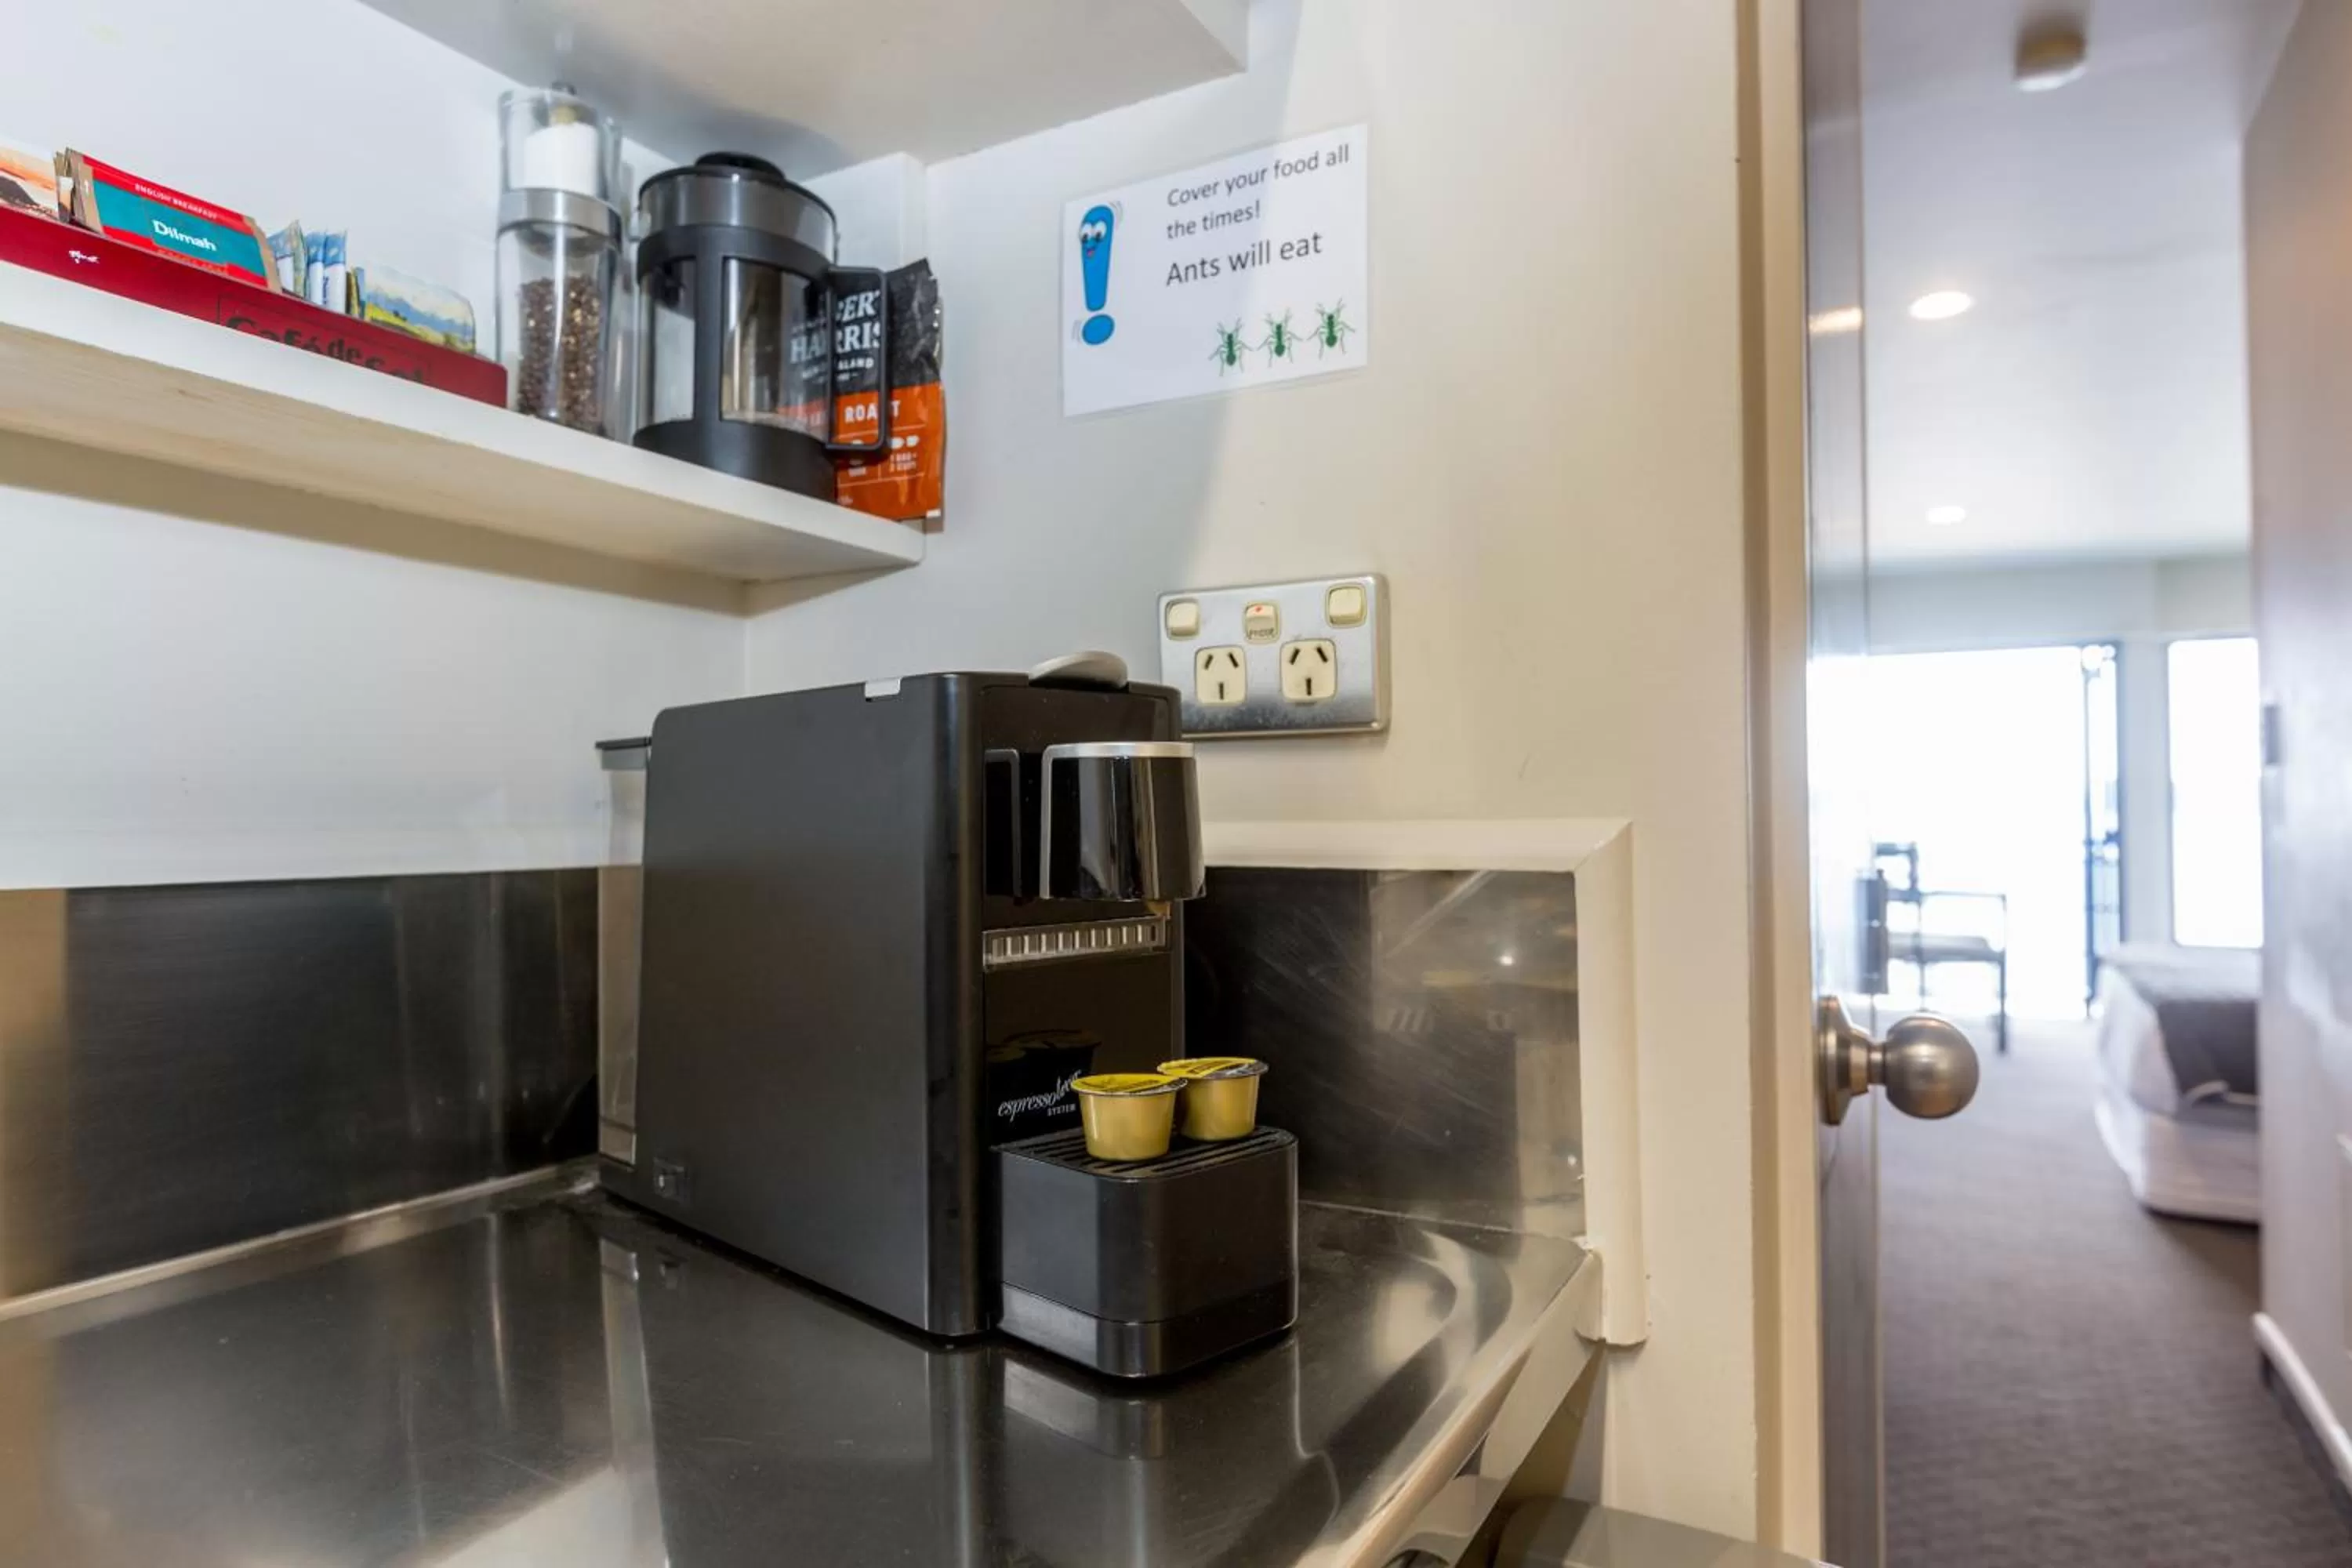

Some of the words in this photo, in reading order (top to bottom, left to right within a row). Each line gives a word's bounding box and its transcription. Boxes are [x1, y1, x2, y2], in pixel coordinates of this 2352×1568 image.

[1167, 181, 1219, 207] Cover
[1225, 168, 1267, 197] your
[1273, 151, 1319, 179] food
[1326, 143, 1349, 166] all
[152, 219, 217, 252] Dilmah
[1167, 220, 1196, 239] the
[1202, 199, 1261, 230] times!
[1166, 257, 1221, 286] Ants
[1229, 240, 1271, 272] will
[1279, 232, 1323, 260] eat
[844, 400, 901, 424] ROAT
